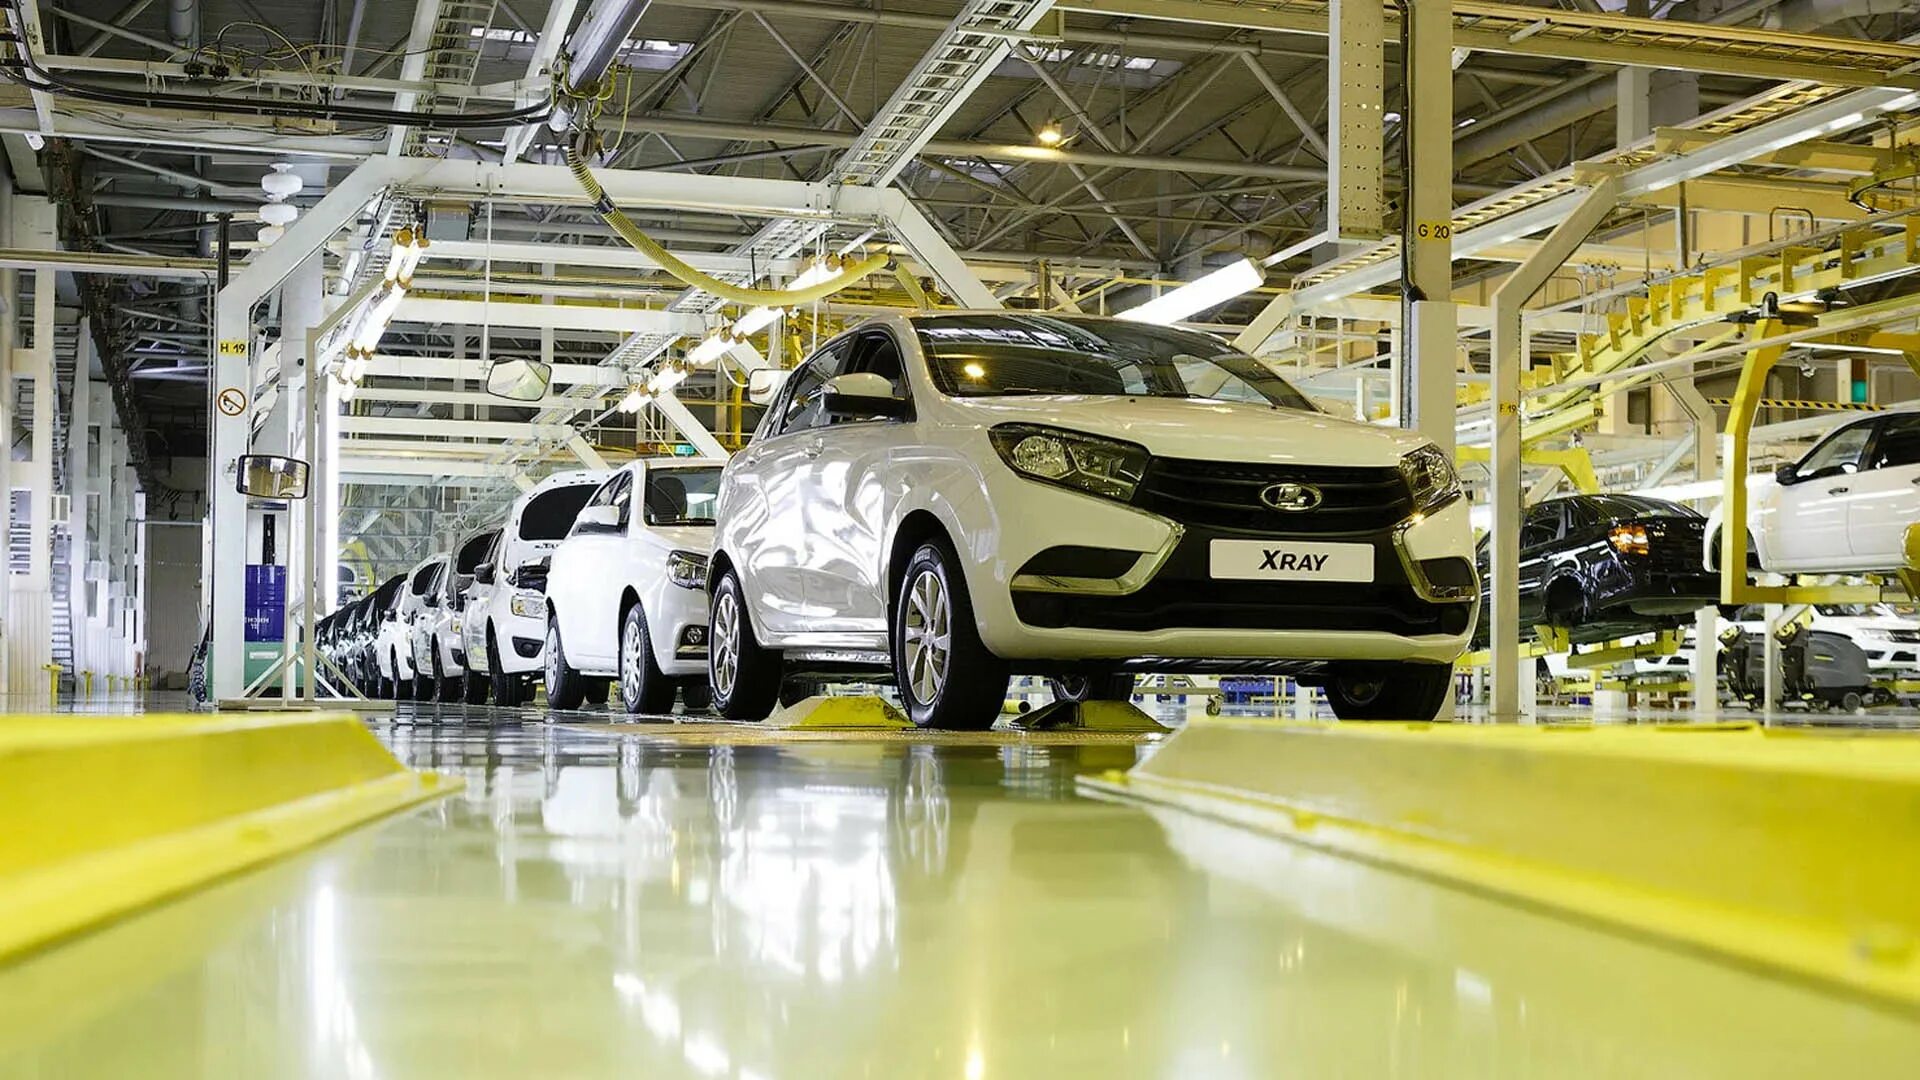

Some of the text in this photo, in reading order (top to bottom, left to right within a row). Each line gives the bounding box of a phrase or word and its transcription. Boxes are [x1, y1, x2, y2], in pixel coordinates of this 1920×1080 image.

[1418, 223, 1450, 239] G 20
[220, 343, 246, 354] H 19
[1508, 404, 1517, 413] 19
[1258, 549, 1330, 571] XRAY
